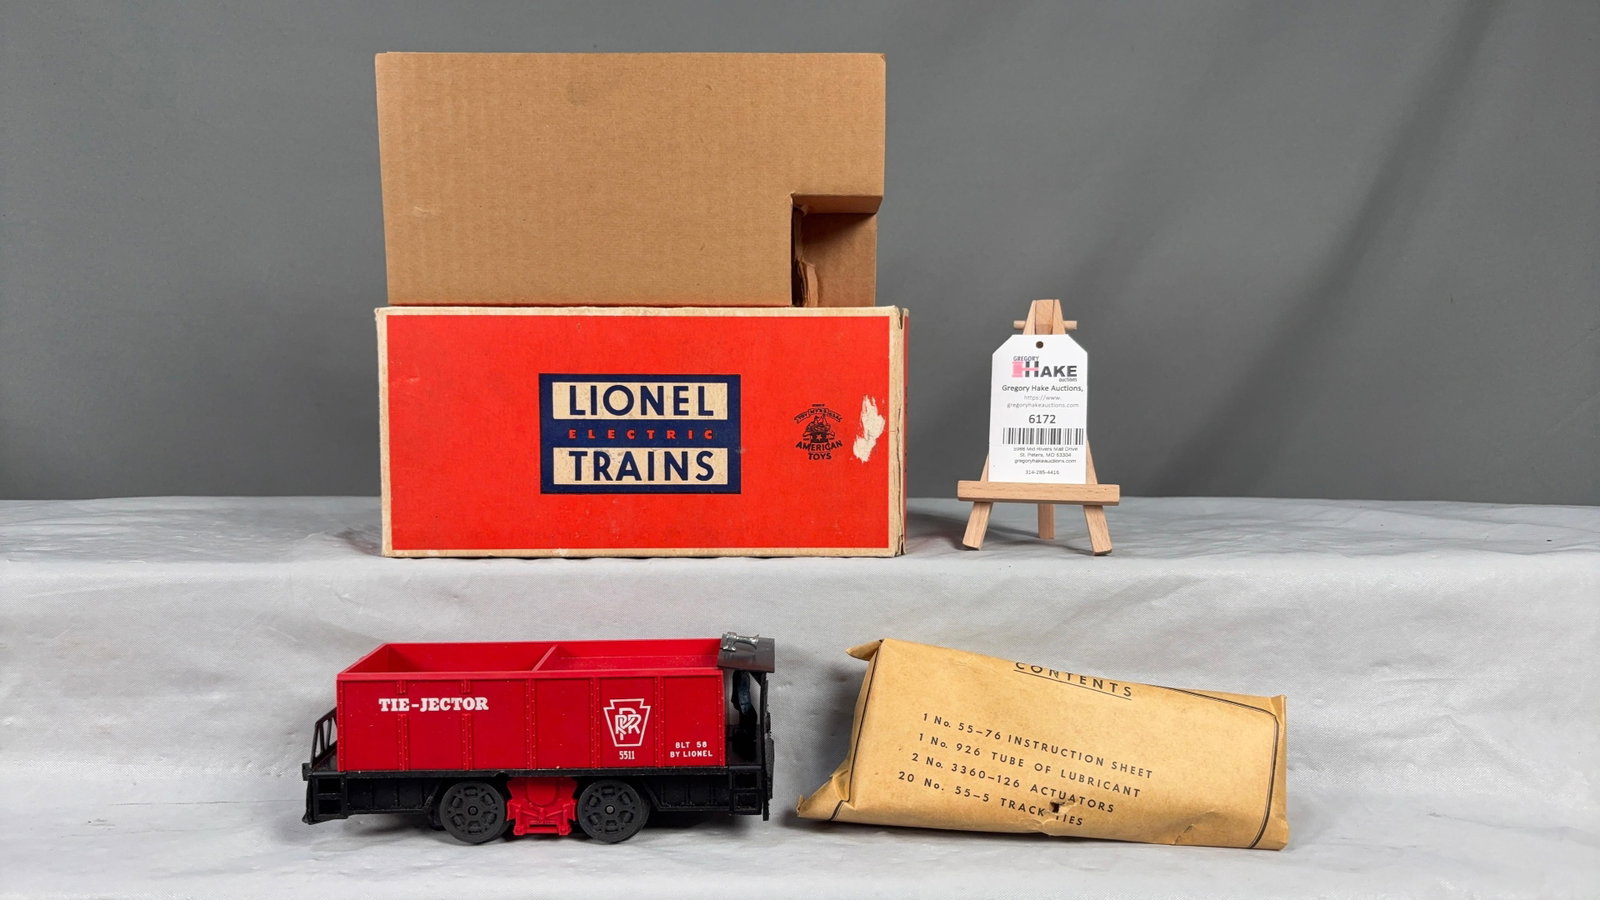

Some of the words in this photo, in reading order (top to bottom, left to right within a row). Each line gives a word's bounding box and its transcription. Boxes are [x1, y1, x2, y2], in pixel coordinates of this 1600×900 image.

[1002, 384, 1030, 392] Gregory
[1051, 384, 1084, 392] Auctions,
[569, 385, 713, 416] LIONEL
[1028, 414, 1056, 424] 6172
[568, 429, 714, 439] ELECTRIC
[796, 440, 843, 451] AMERICAN
[808, 452, 832, 460] TOYS
[569, 451, 714, 481] TRAINS
[1015, 662, 1132, 697] CONTENTS
[379, 697, 489, 712] TIE-JECTOR
[923, 713, 928, 721] 1
[934, 715, 951, 728] No.
[958, 722, 1001, 740] 55-76
[1008, 734, 1104, 766] INSTRUCTION
[1111, 761, 1153, 779] SHEET
[619, 751, 635, 760] 5511
[683, 750, 713, 758] LIONEL
[919, 733, 924, 741] 1
[930, 736, 948, 749] No.
[956, 743, 981, 756] 926
[991, 752, 1024, 767] TUBE
[1034, 763, 1051, 774] OF
[1060, 769, 1141, 798] LUBRICANT
[912, 753, 919, 762] 2
[925, 756, 944, 769] No.
[951, 763, 1020, 788] 3360-126
[1030, 784, 1114, 813] ACTUATORS
[898, 771, 915, 783] 20
[924, 777, 944, 791] No.
[955, 785, 990, 802] 55-5
[1000, 797, 1045, 817] TRACK
